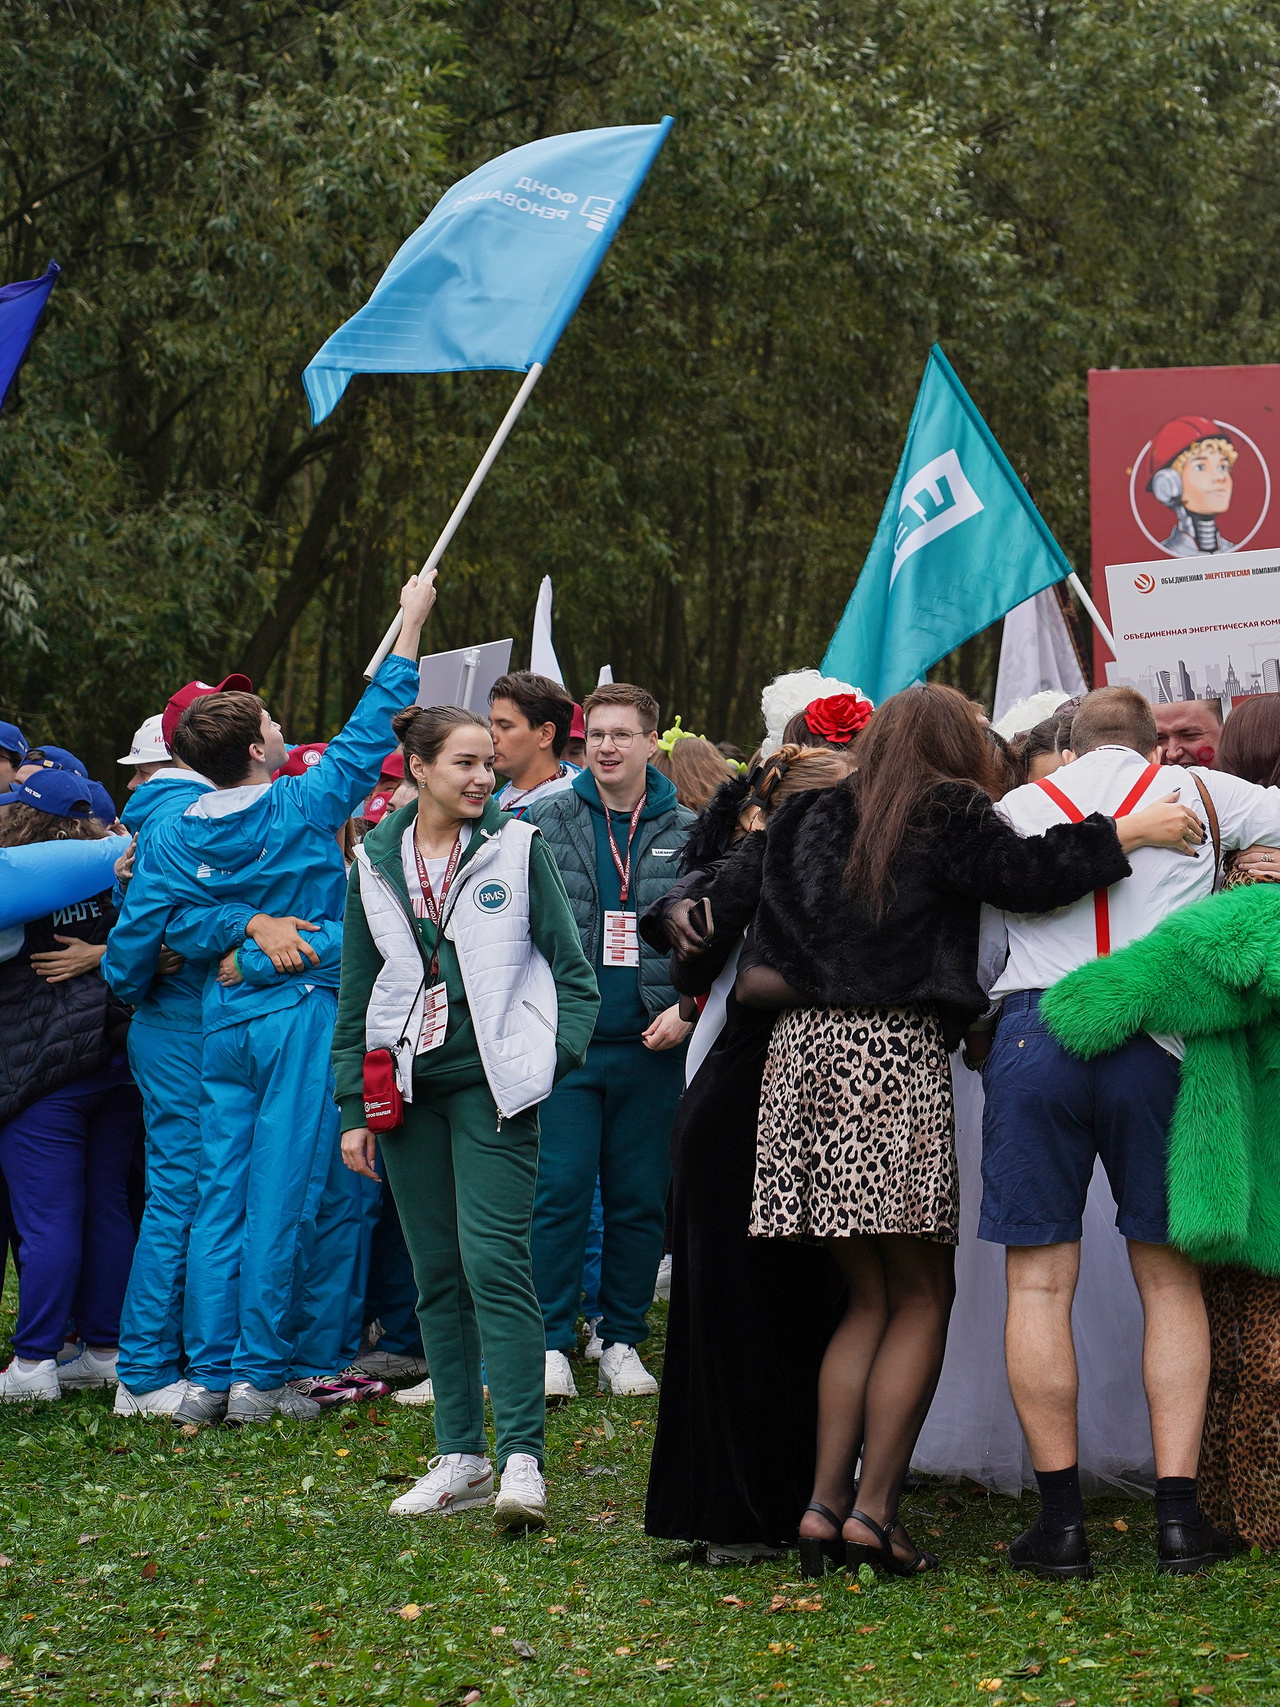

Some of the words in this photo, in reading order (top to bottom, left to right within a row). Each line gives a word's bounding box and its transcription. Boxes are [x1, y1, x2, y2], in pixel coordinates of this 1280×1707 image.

[1161, 574, 1203, 585] ОБЪЕДИНЕННАЯ
[1204, 569, 1251, 581] ЭНЕРГЕТИЧЕСКАЯ
[1123, 628, 1188, 641] ОБЪЕДИНЕННАЯ
[1189, 621, 1259, 634] ЭНЕРГЕТИЧЕСКАЯ
[480, 890, 505, 903] BMS
